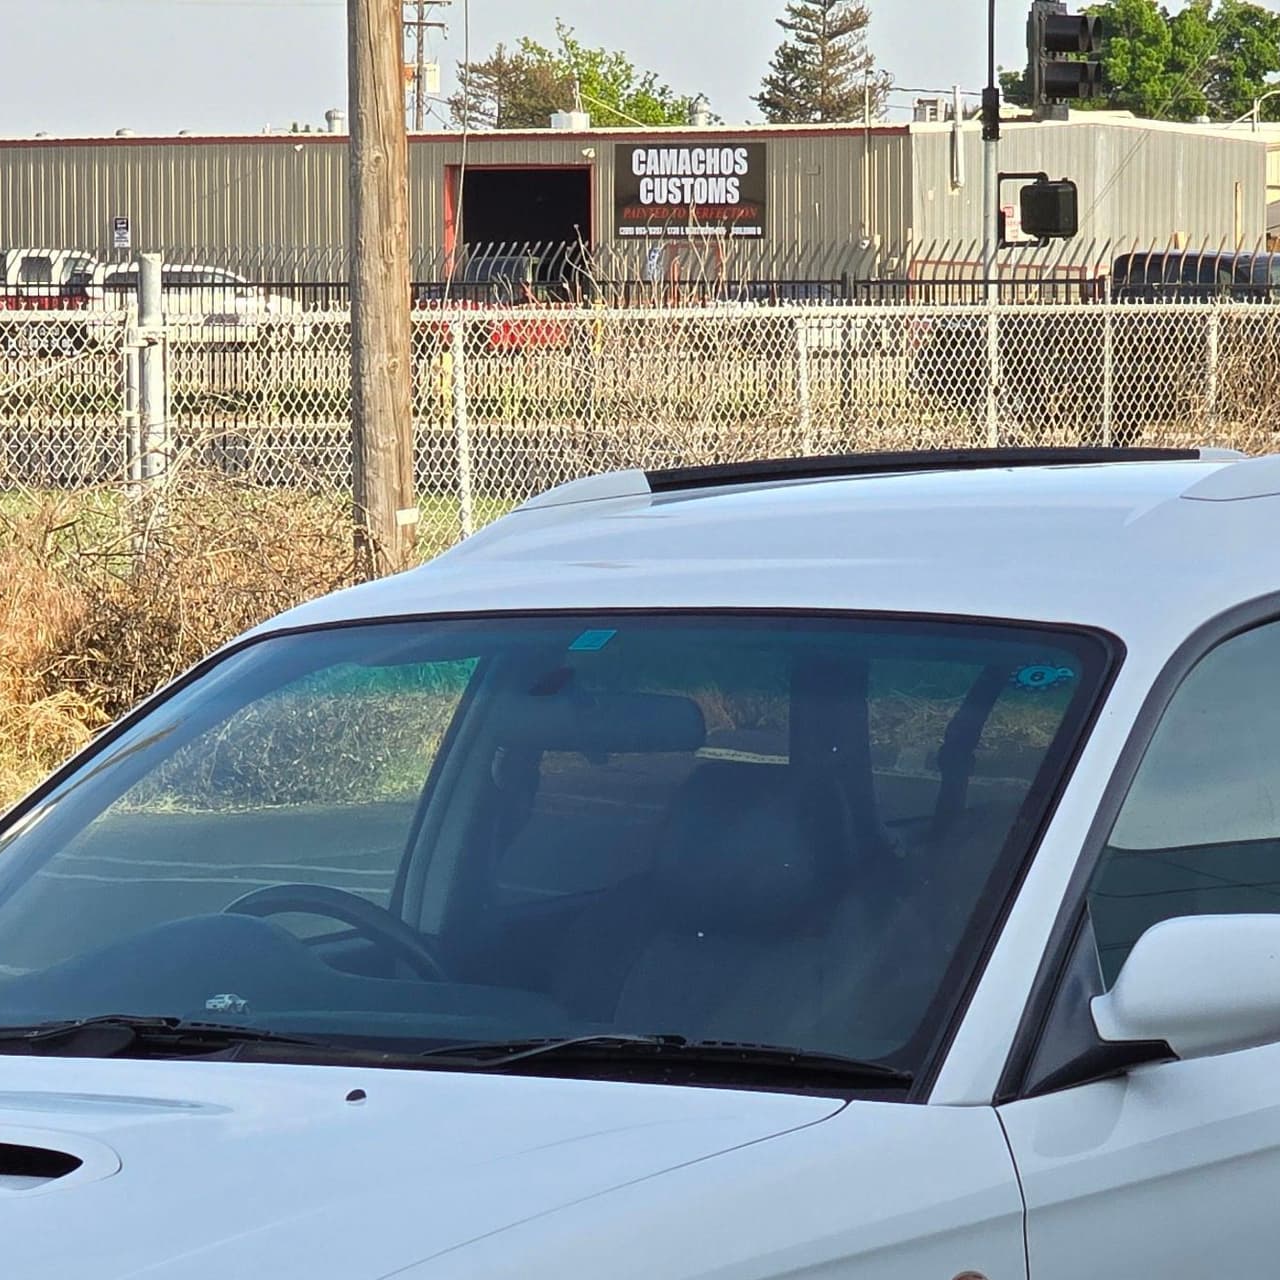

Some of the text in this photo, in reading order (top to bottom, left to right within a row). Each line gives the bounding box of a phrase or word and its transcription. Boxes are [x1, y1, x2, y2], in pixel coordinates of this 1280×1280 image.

[632, 148, 748, 176] CAMACHOS
[639, 177, 740, 205] CUSTOMS
[623, 207, 670, 219] PAINTED
[671, 207, 687, 219] TO
